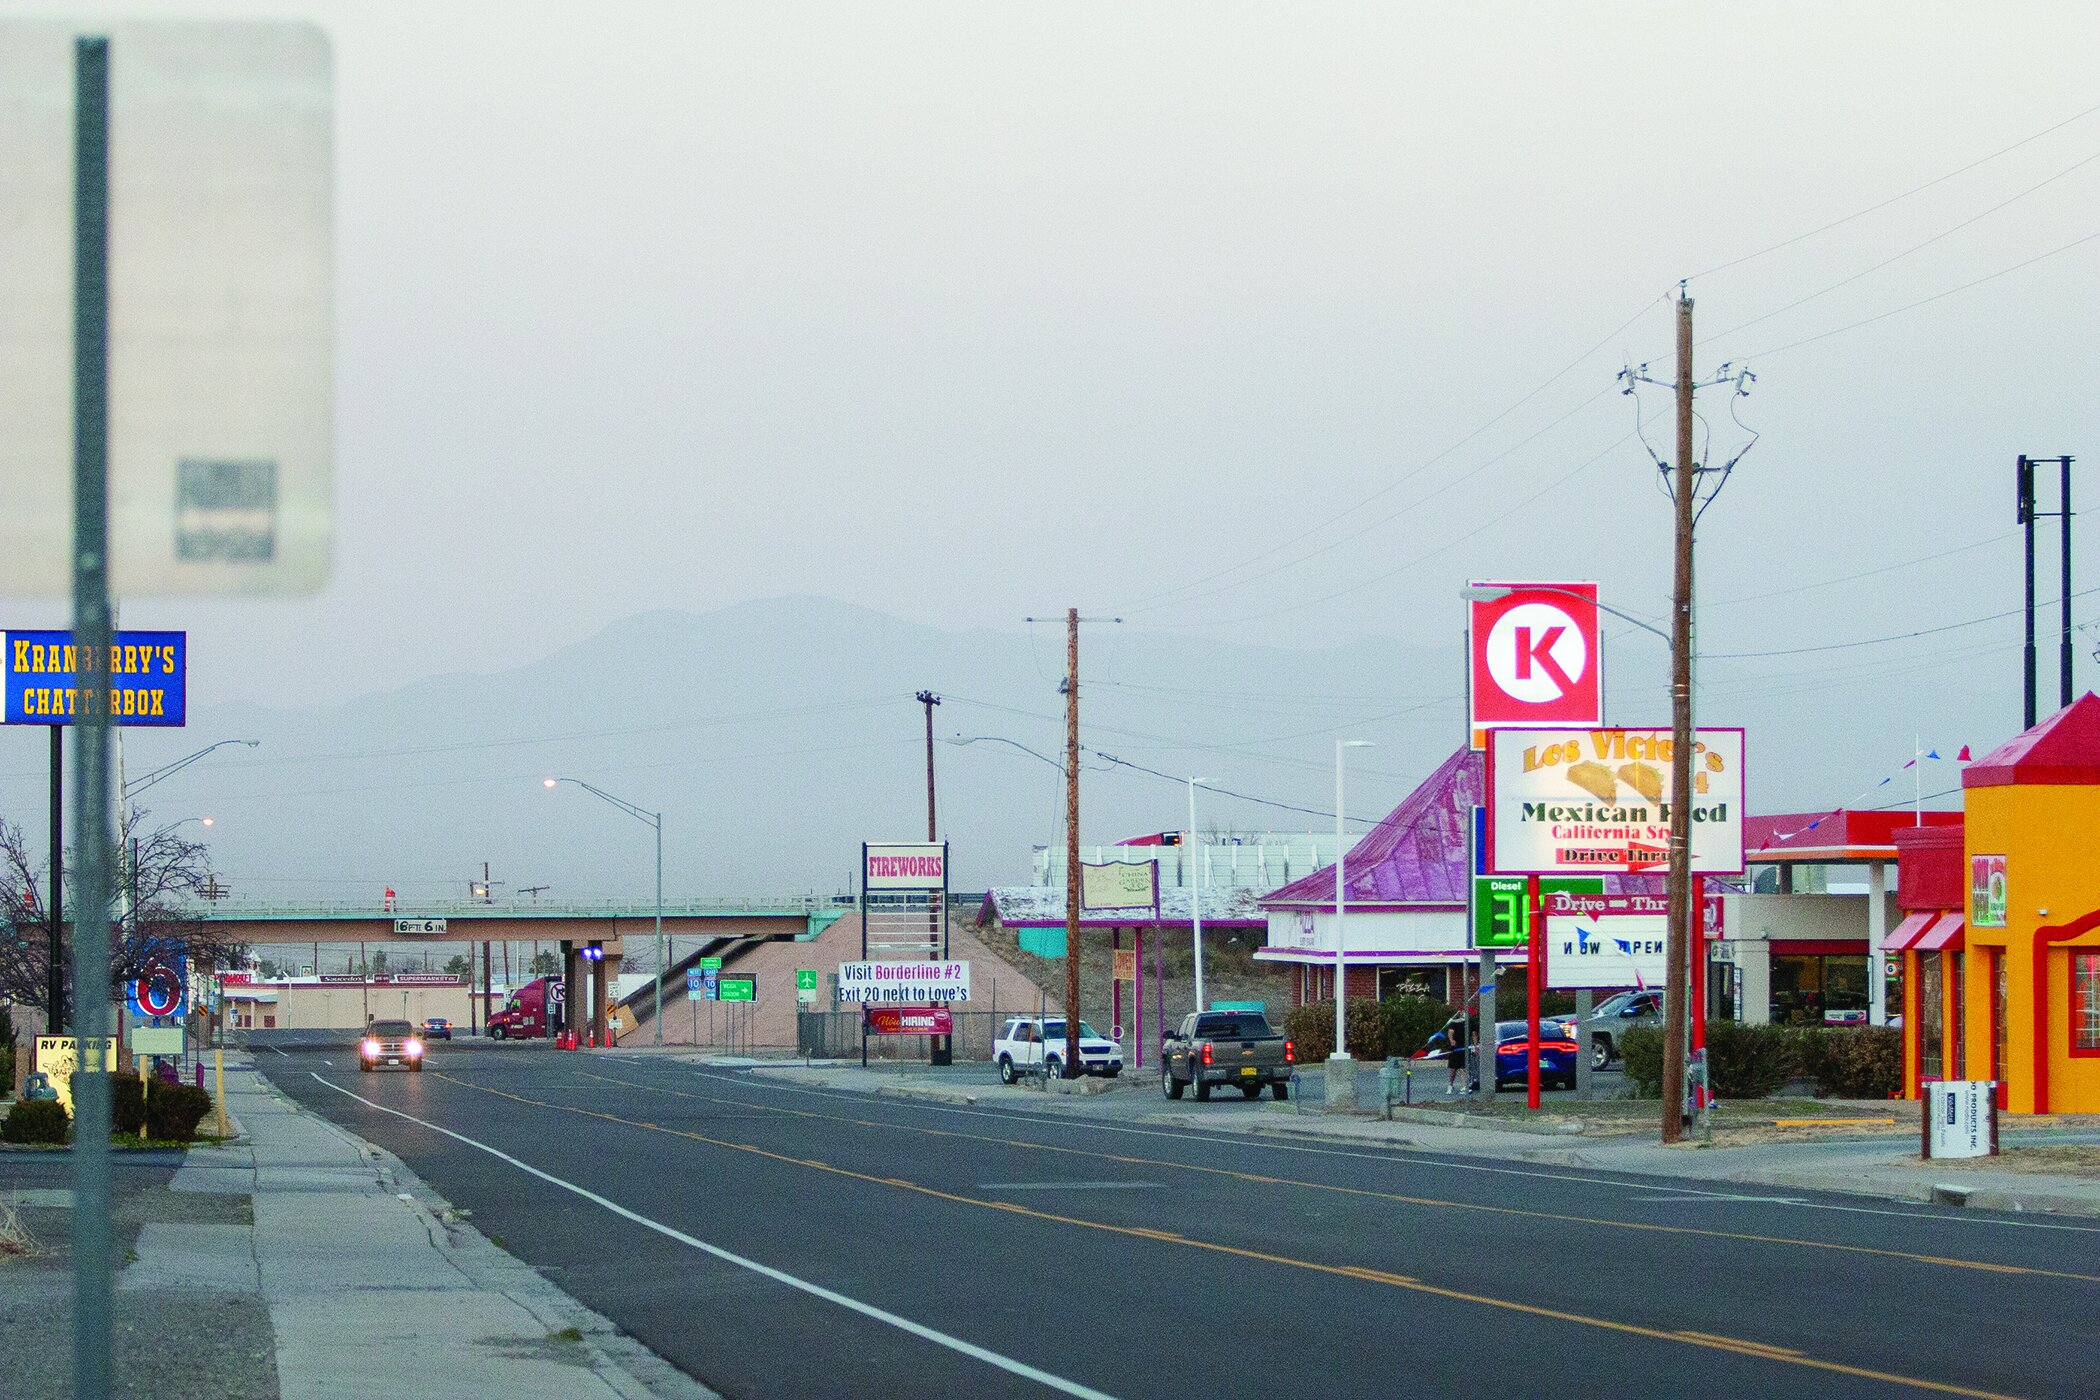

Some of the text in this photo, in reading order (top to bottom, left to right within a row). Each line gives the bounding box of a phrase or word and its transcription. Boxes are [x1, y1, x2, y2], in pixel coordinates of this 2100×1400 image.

[13, 640, 175, 674] KRANRRY'S
[1514, 626, 1574, 695] K
[23, 688, 164, 715] CHATTRBOX
[1523, 739, 1581, 774] Los
[1520, 802, 1727, 823] Mexican Fod
[1551, 825, 1673, 842] California Sty
[1564, 849, 1619, 862] Drive
[869, 856, 942, 877] FIREWORKS
[1491, 882, 1521, 890] Diesel
[1555, 896, 1669, 911] Drive Thr
[396, 921, 408, 931] 16
[424, 921, 433, 931] 6
[845, 964, 961, 980] Visit Borderline #2
[706, 980, 716, 988] 10
[839, 987, 861, 1002] Exit
[865, 987, 879, 1001] 20
[883, 987, 909, 1001] next
[913, 987, 925, 1001] to
[901, 1016, 935, 1027] HIRING
[41, 1040, 57, 1050] RV
